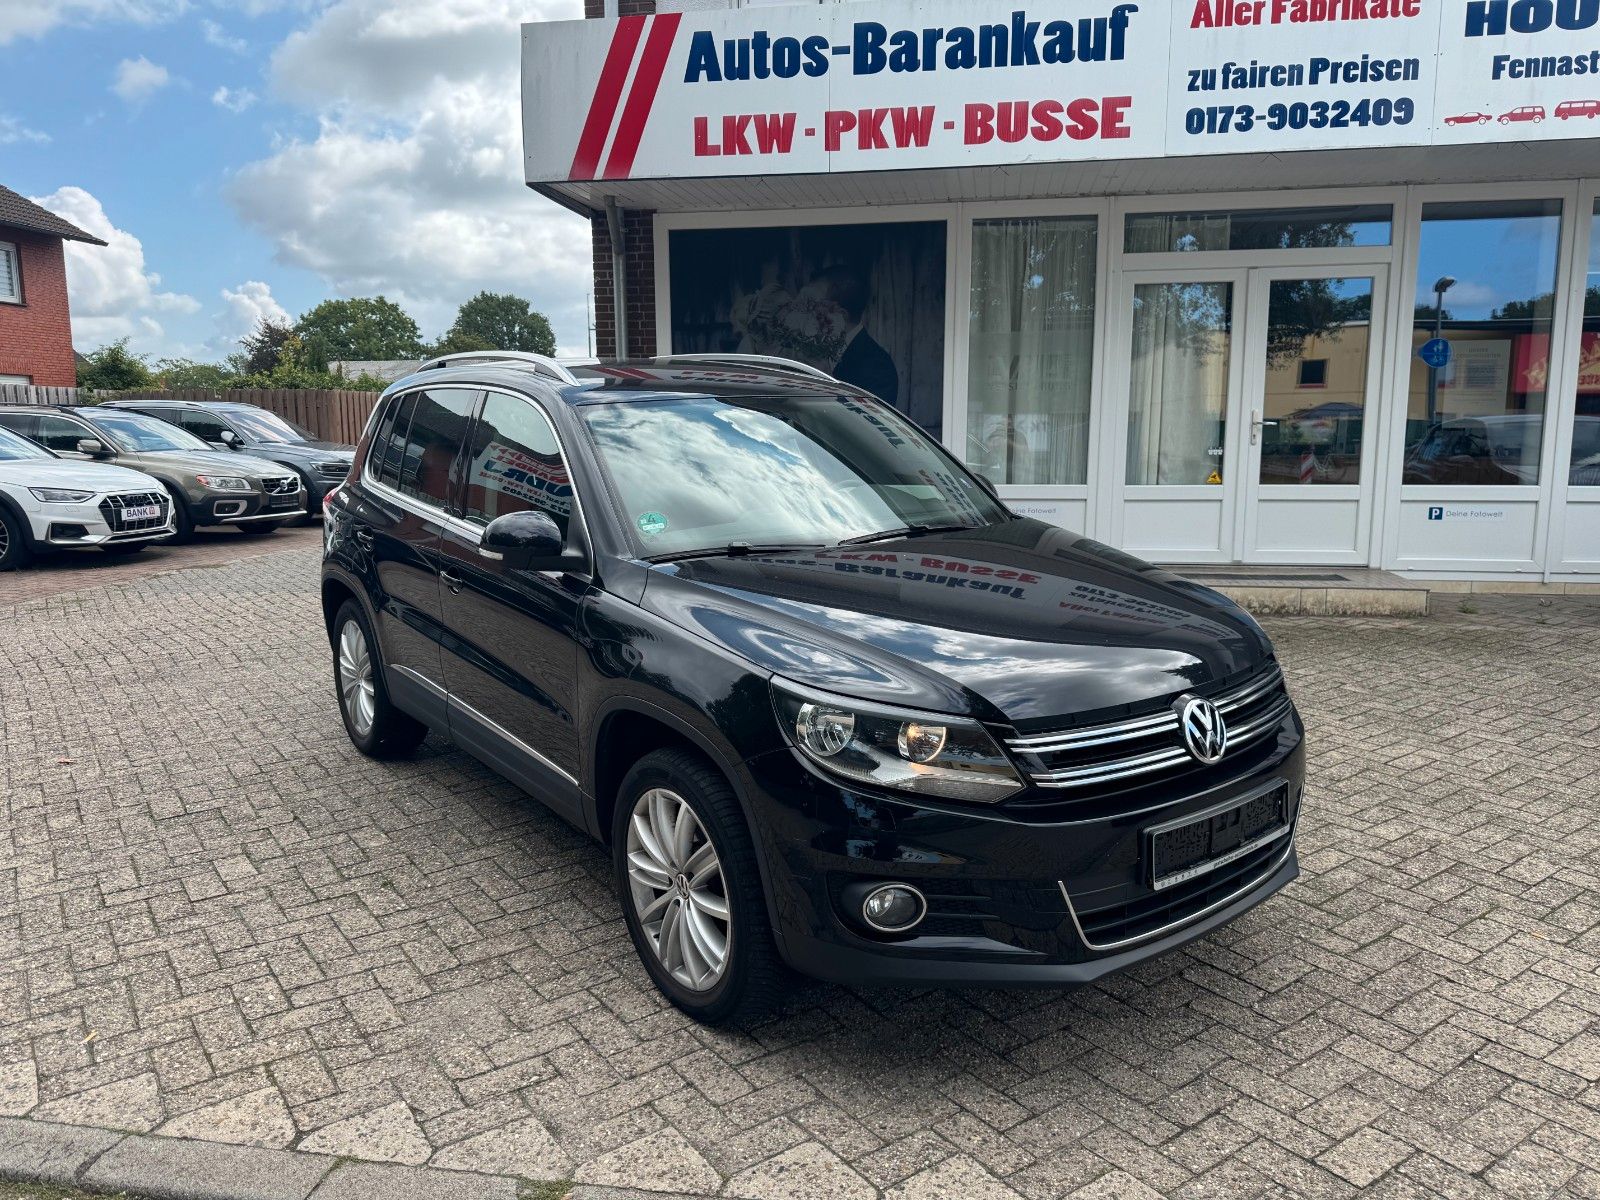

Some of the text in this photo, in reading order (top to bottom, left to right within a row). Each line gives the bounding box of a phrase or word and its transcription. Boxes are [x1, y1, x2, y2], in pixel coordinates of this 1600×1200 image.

[1190, 0, 1421, 28] Aller Fabrikate
[684, 4, 1138, 82] Autos-Barankauf
[1187, 54, 1420, 91] zu fairen Preisen
[694, 112, 797, 157] LKW
[825, 105, 935, 152] PKW
[964, 96, 1132, 145] BUSSE
[1185, 97, 1414, 135] 0173-9032409
[126, 507, 149, 518] BANK
[1446, 510, 1468, 518] Deine
